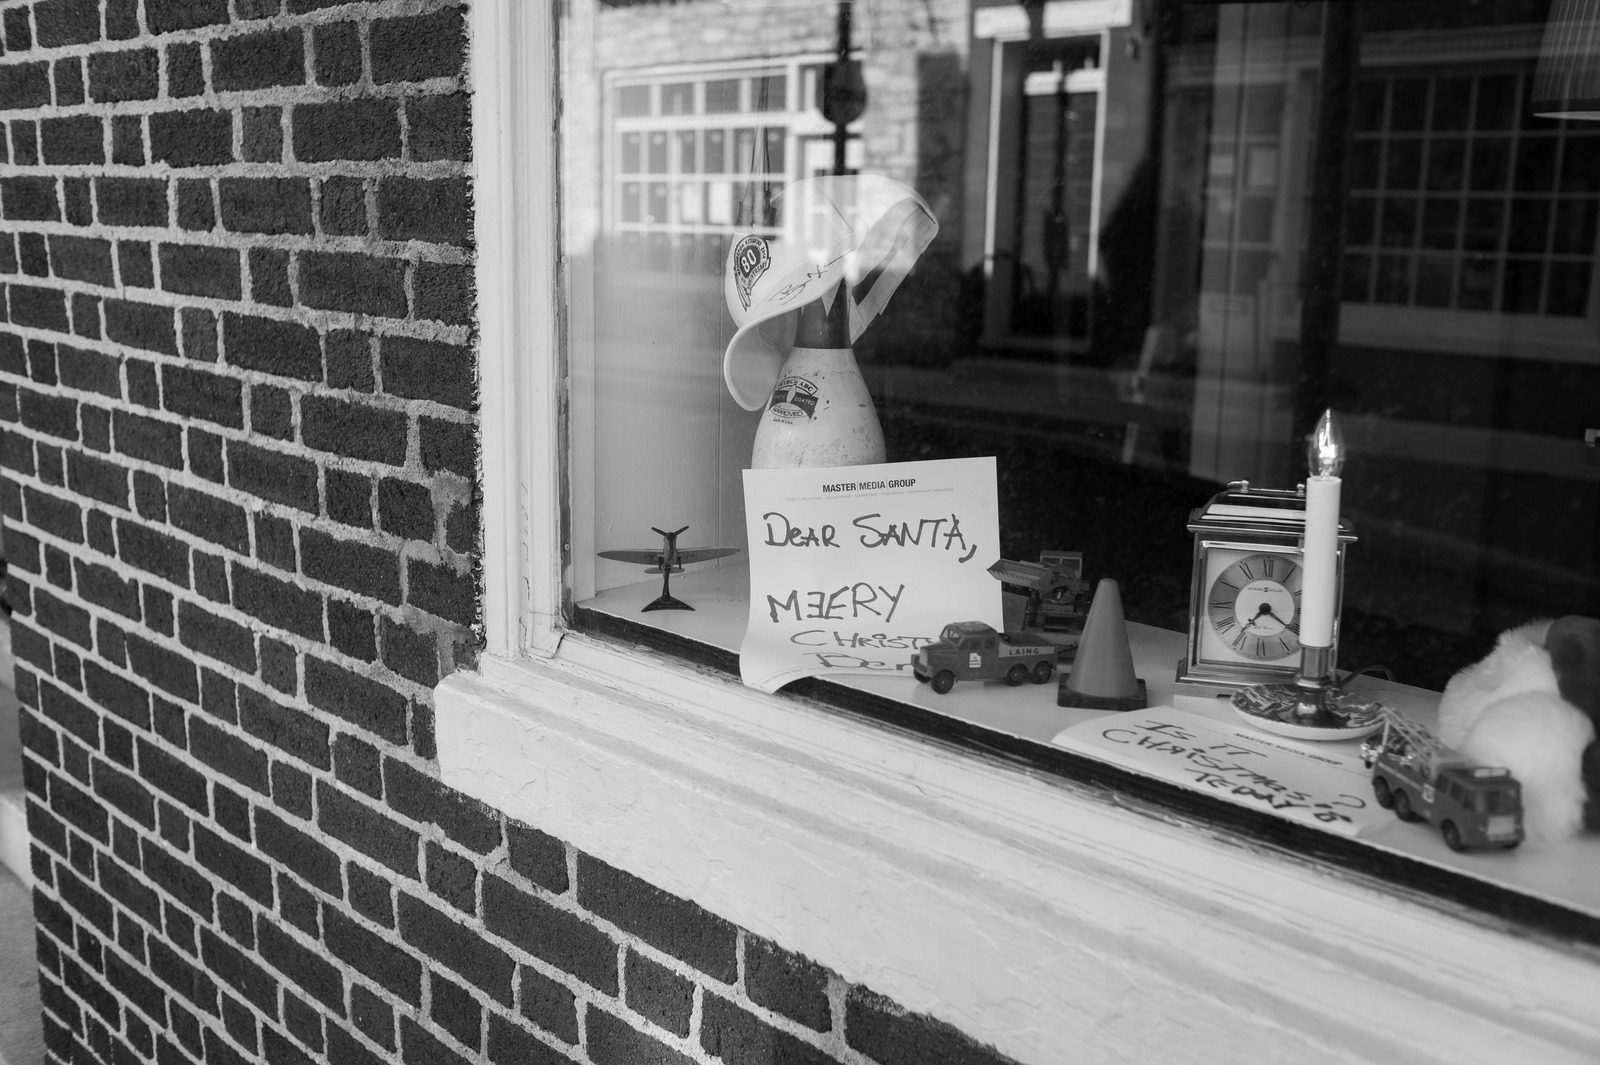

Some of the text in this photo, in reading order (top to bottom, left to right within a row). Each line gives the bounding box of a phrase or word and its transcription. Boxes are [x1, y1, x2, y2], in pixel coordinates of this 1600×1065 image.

[741, 249, 757, 273] 80
[799, 381, 814, 392] ABC
[794, 396, 815, 406] COATED
[822, 478, 916, 493] MASTER MEDIA GROUP
[852, 512, 978, 563] SANTA,
[1009, 647, 1040, 656] LAING
[1208, 743, 1268, 758] IT
[1234, 732, 1343, 766] MASTER MEDIA GROUP
